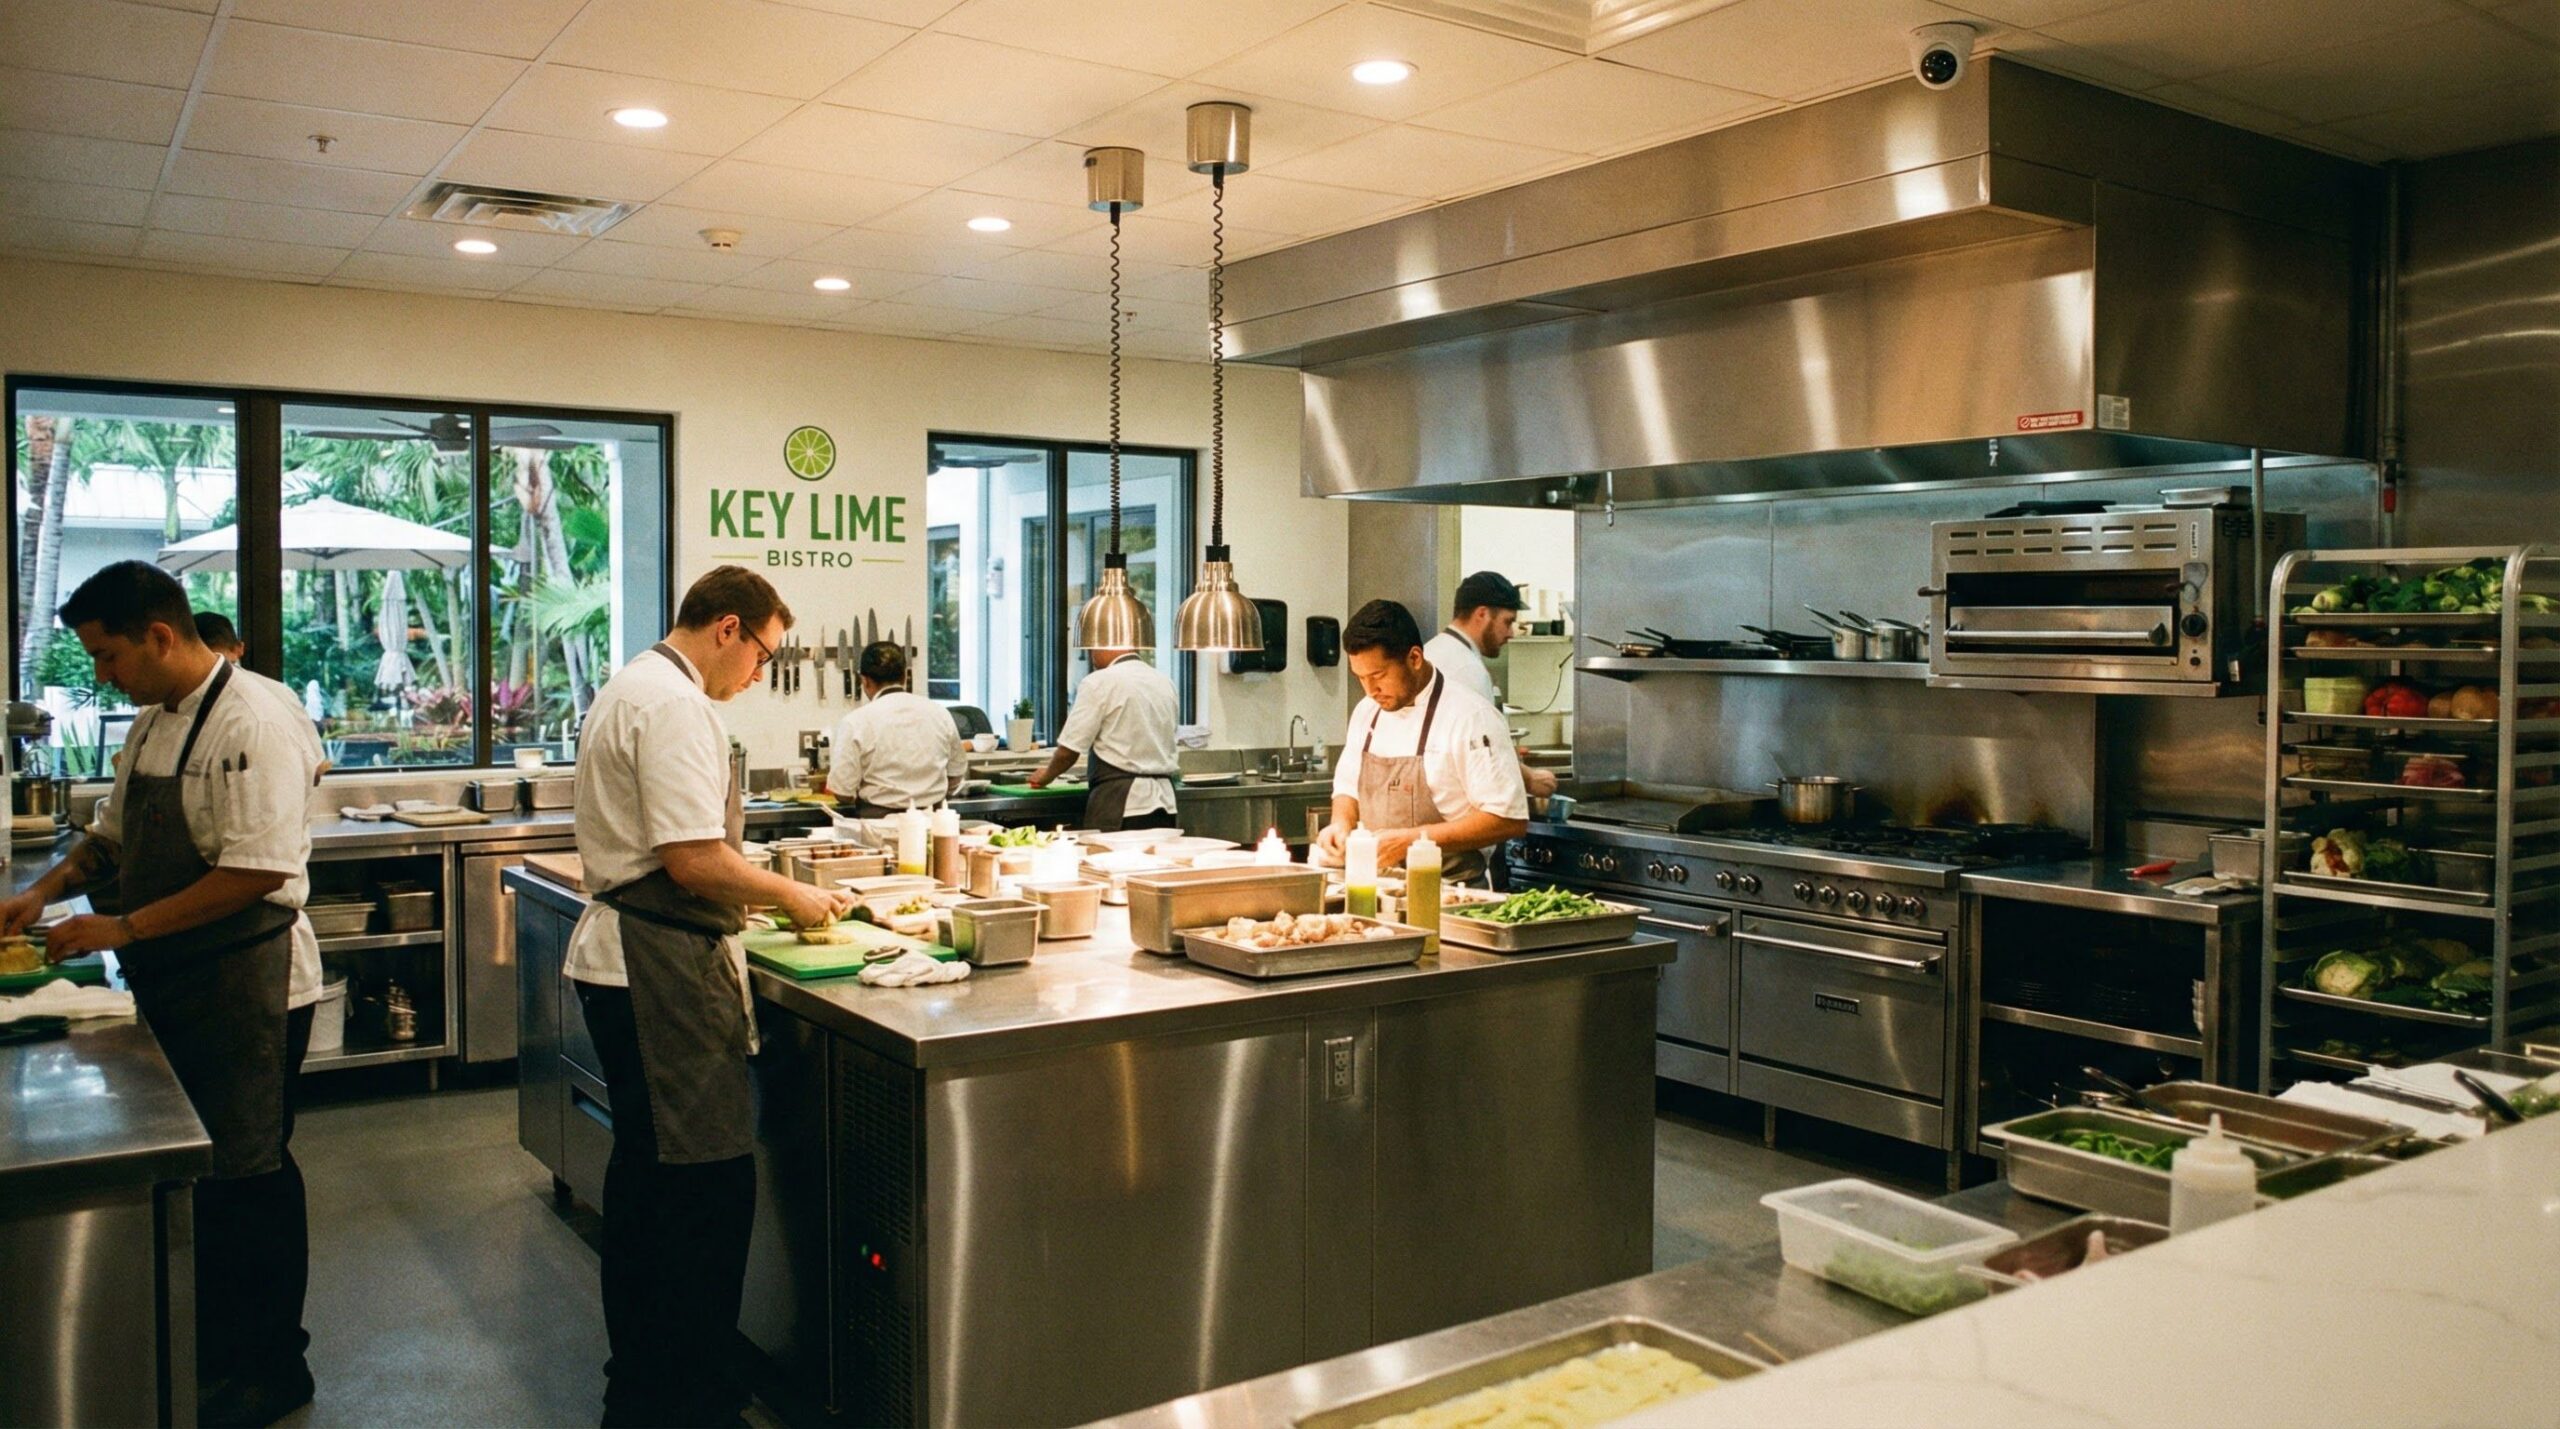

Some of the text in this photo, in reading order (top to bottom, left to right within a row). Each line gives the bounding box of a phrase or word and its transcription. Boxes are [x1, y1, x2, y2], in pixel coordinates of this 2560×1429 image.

[710, 488, 906, 543] KEY LIME
[767, 549, 853, 568] BISTRO
